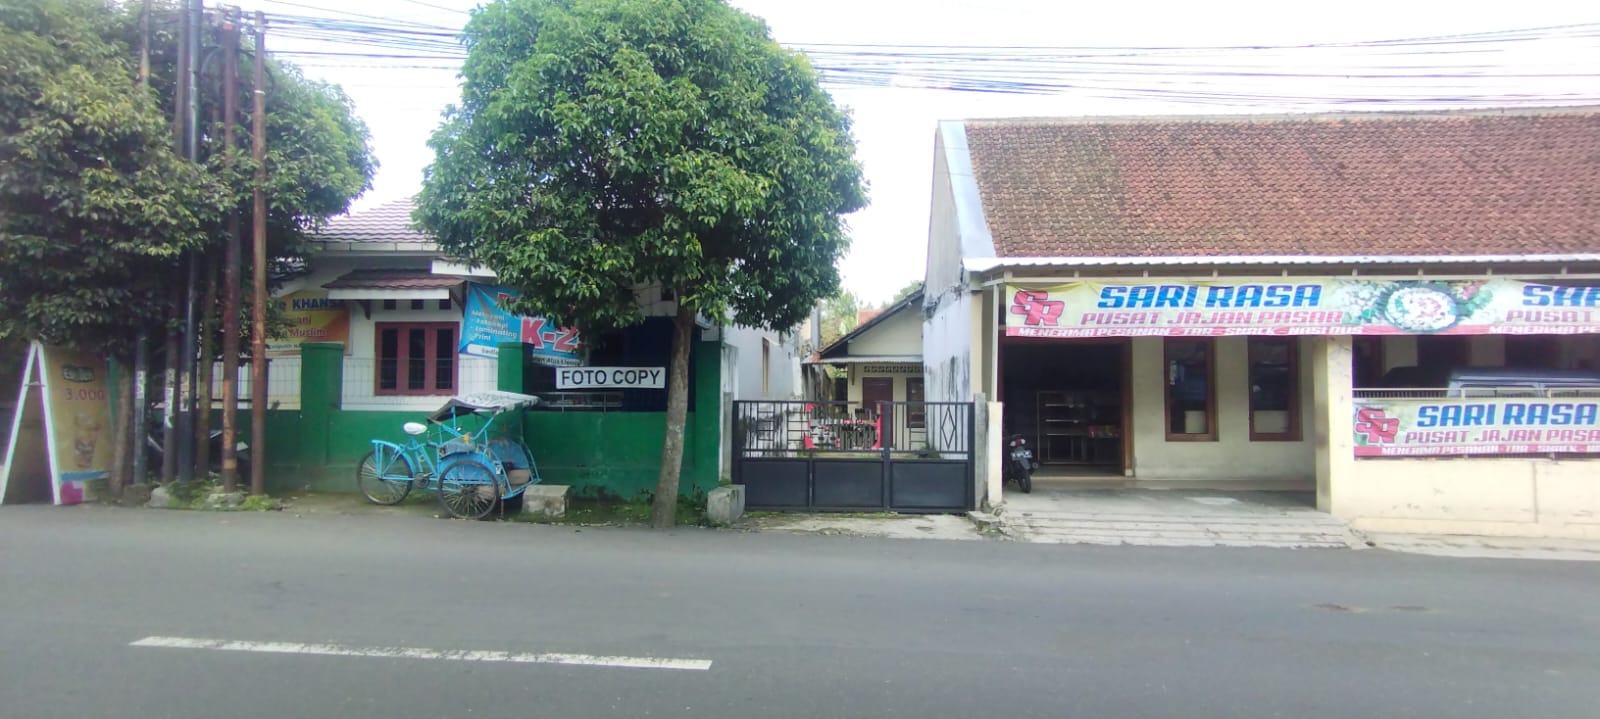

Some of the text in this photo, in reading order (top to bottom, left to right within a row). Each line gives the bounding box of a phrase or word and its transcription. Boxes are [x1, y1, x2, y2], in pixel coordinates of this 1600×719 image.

[1097, 284, 1322, 309] SARI RASA
[1010, 290, 1065, 326] SR
[1080, 310, 1344, 325] PUSAT JAJAN PASAR
[1505, 310, 1594, 322] PUSAT
[561, 369, 660, 385] FOTO COPY
[1416, 403, 1598, 427] SARI RASA
[1355, 407, 1400, 444] SR
[1405, 430, 1470, 443] PUSAT
[1474, 429, 1542, 442] JAJAN
